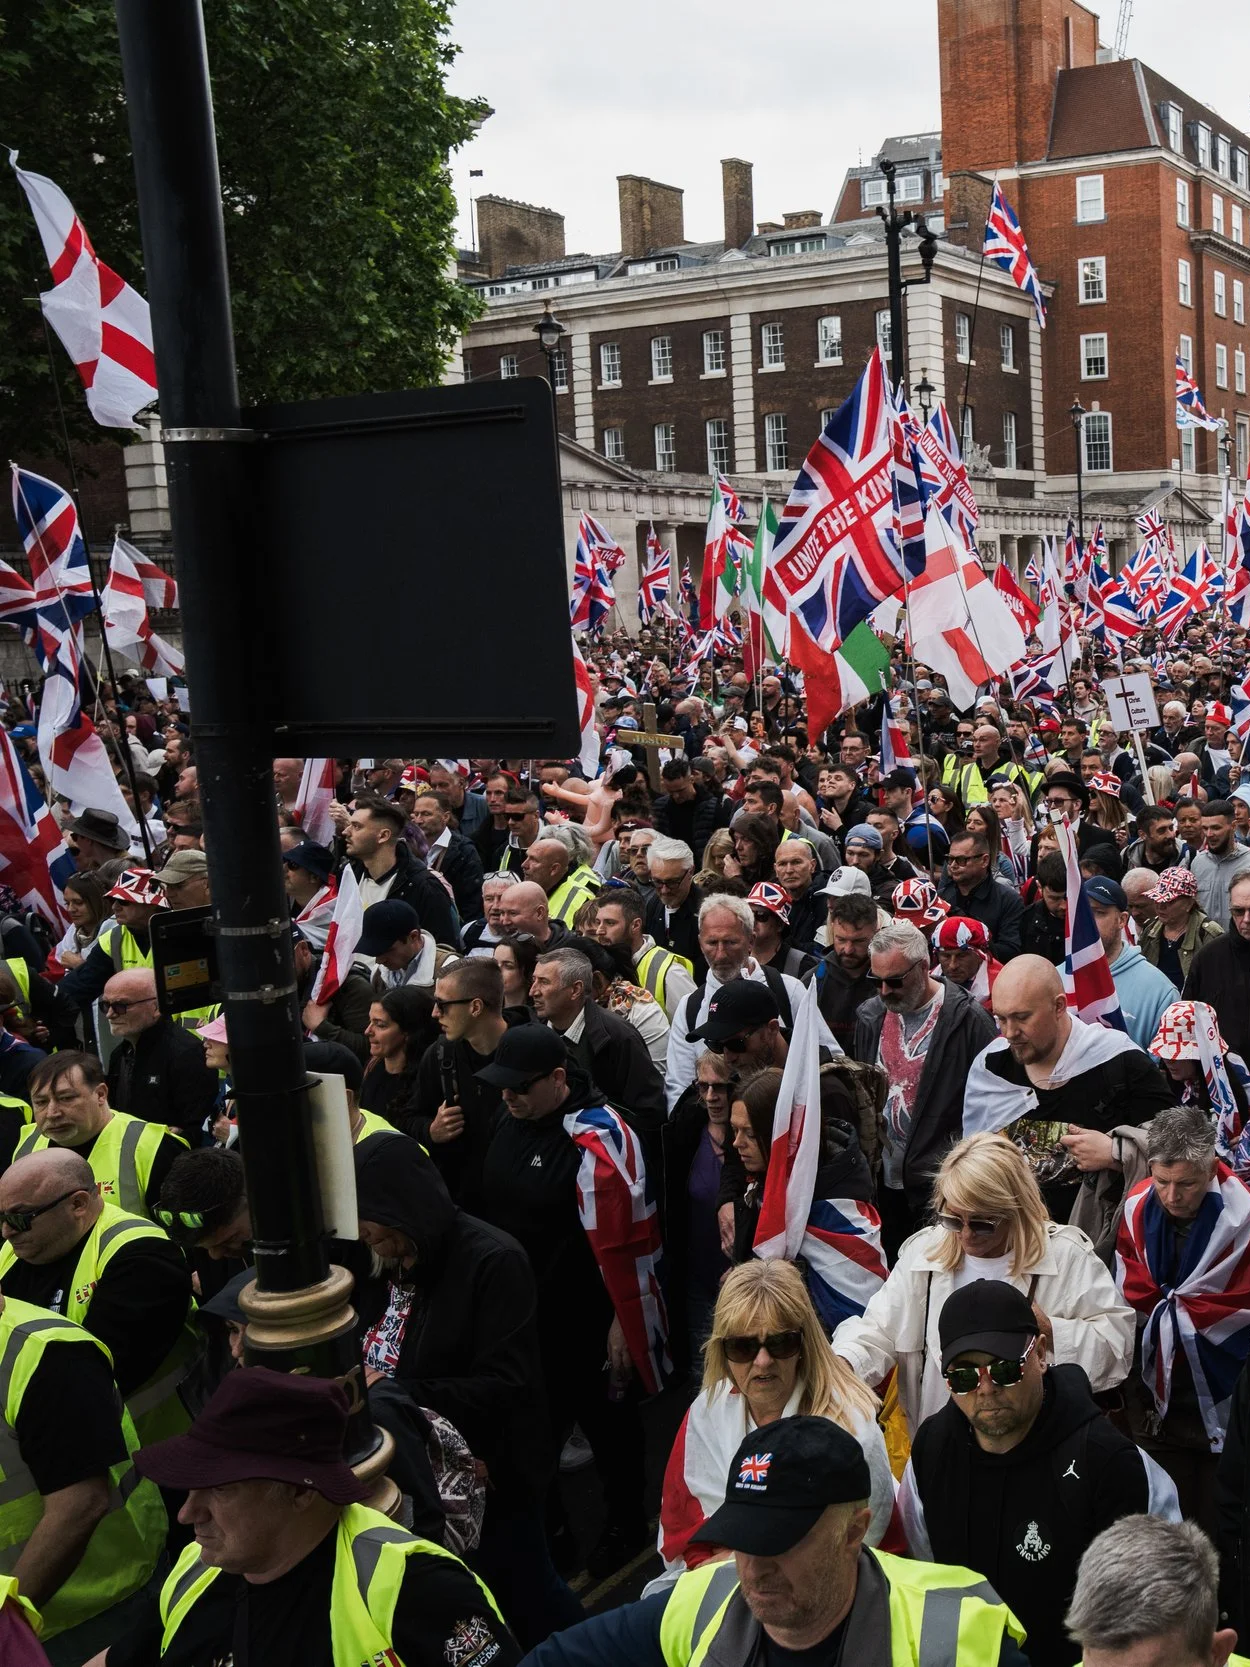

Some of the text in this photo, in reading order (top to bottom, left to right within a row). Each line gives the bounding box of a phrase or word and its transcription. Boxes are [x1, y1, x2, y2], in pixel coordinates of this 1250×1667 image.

[921, 433, 981, 518] UNITE THE KINGDO
[787, 534, 824, 582] UNITE
[817, 499, 859, 553] THE
[600, 550, 617, 562] THE
[1000, 590, 1025, 617] ESUS
[1133, 717, 1149, 725] Country
[633, 736, 670, 746] JESUS
[1016, 1543, 1051, 1561] ENGLAND
